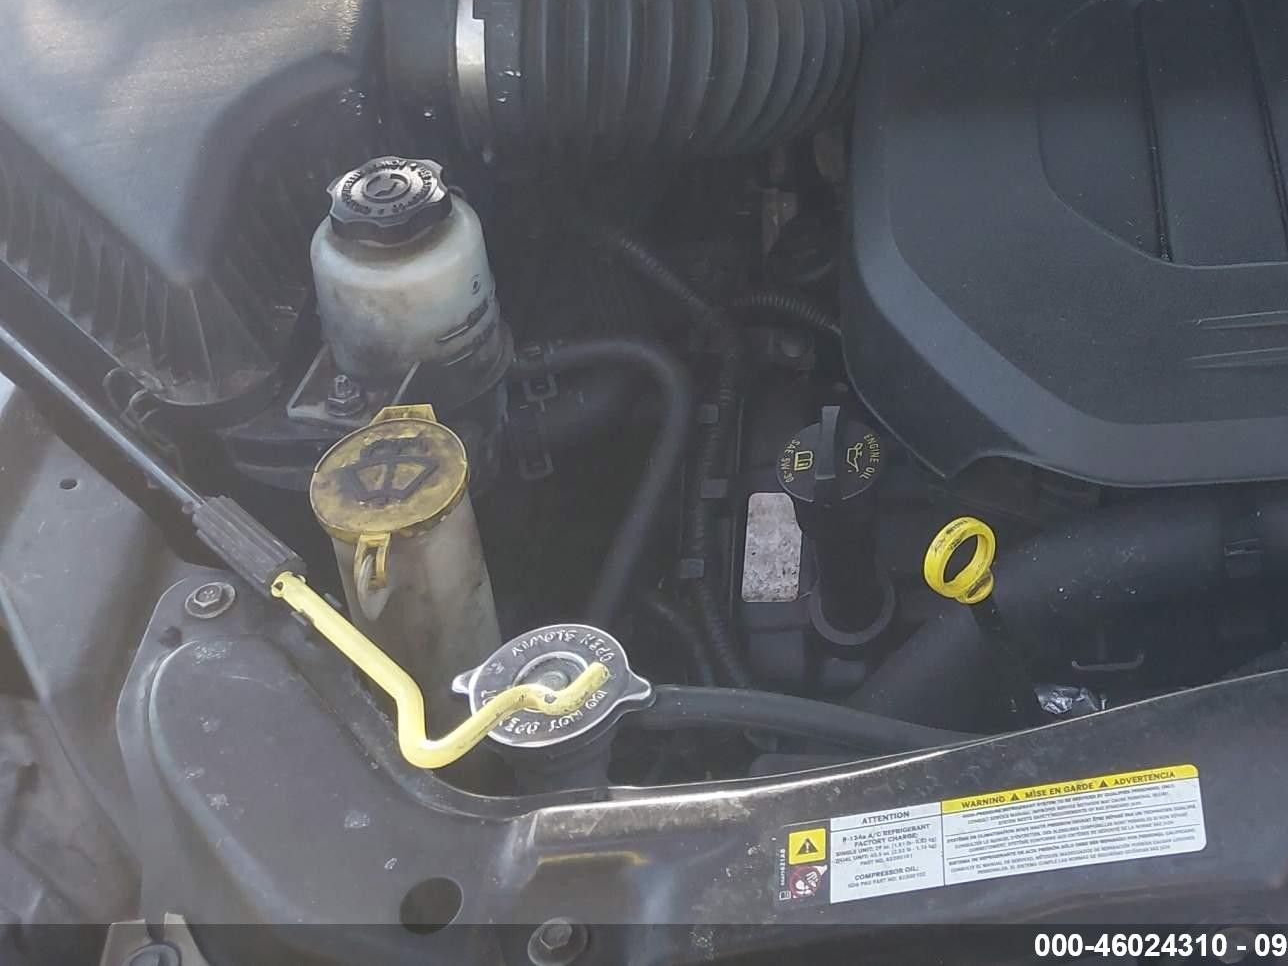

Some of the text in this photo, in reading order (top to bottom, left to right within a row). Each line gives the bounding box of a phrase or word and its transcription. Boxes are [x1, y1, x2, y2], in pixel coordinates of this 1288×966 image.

[786, 439, 801, 454] SAE
[859, 434, 880, 480] ENGINE OIL
[580, 633, 616, 662] OPEN
[961, 795, 1005, 809] WARNING
[1049, 785, 1062, 795] EN
[1063, 781, 1093, 793] GARDE
[1113, 769, 1175, 786] ADVERTENCIA
[862, 811, 909, 824] ATTENTION
[854, 837, 885, 847] FACTORY
[854, 867, 903, 880] COMPRESSOR
